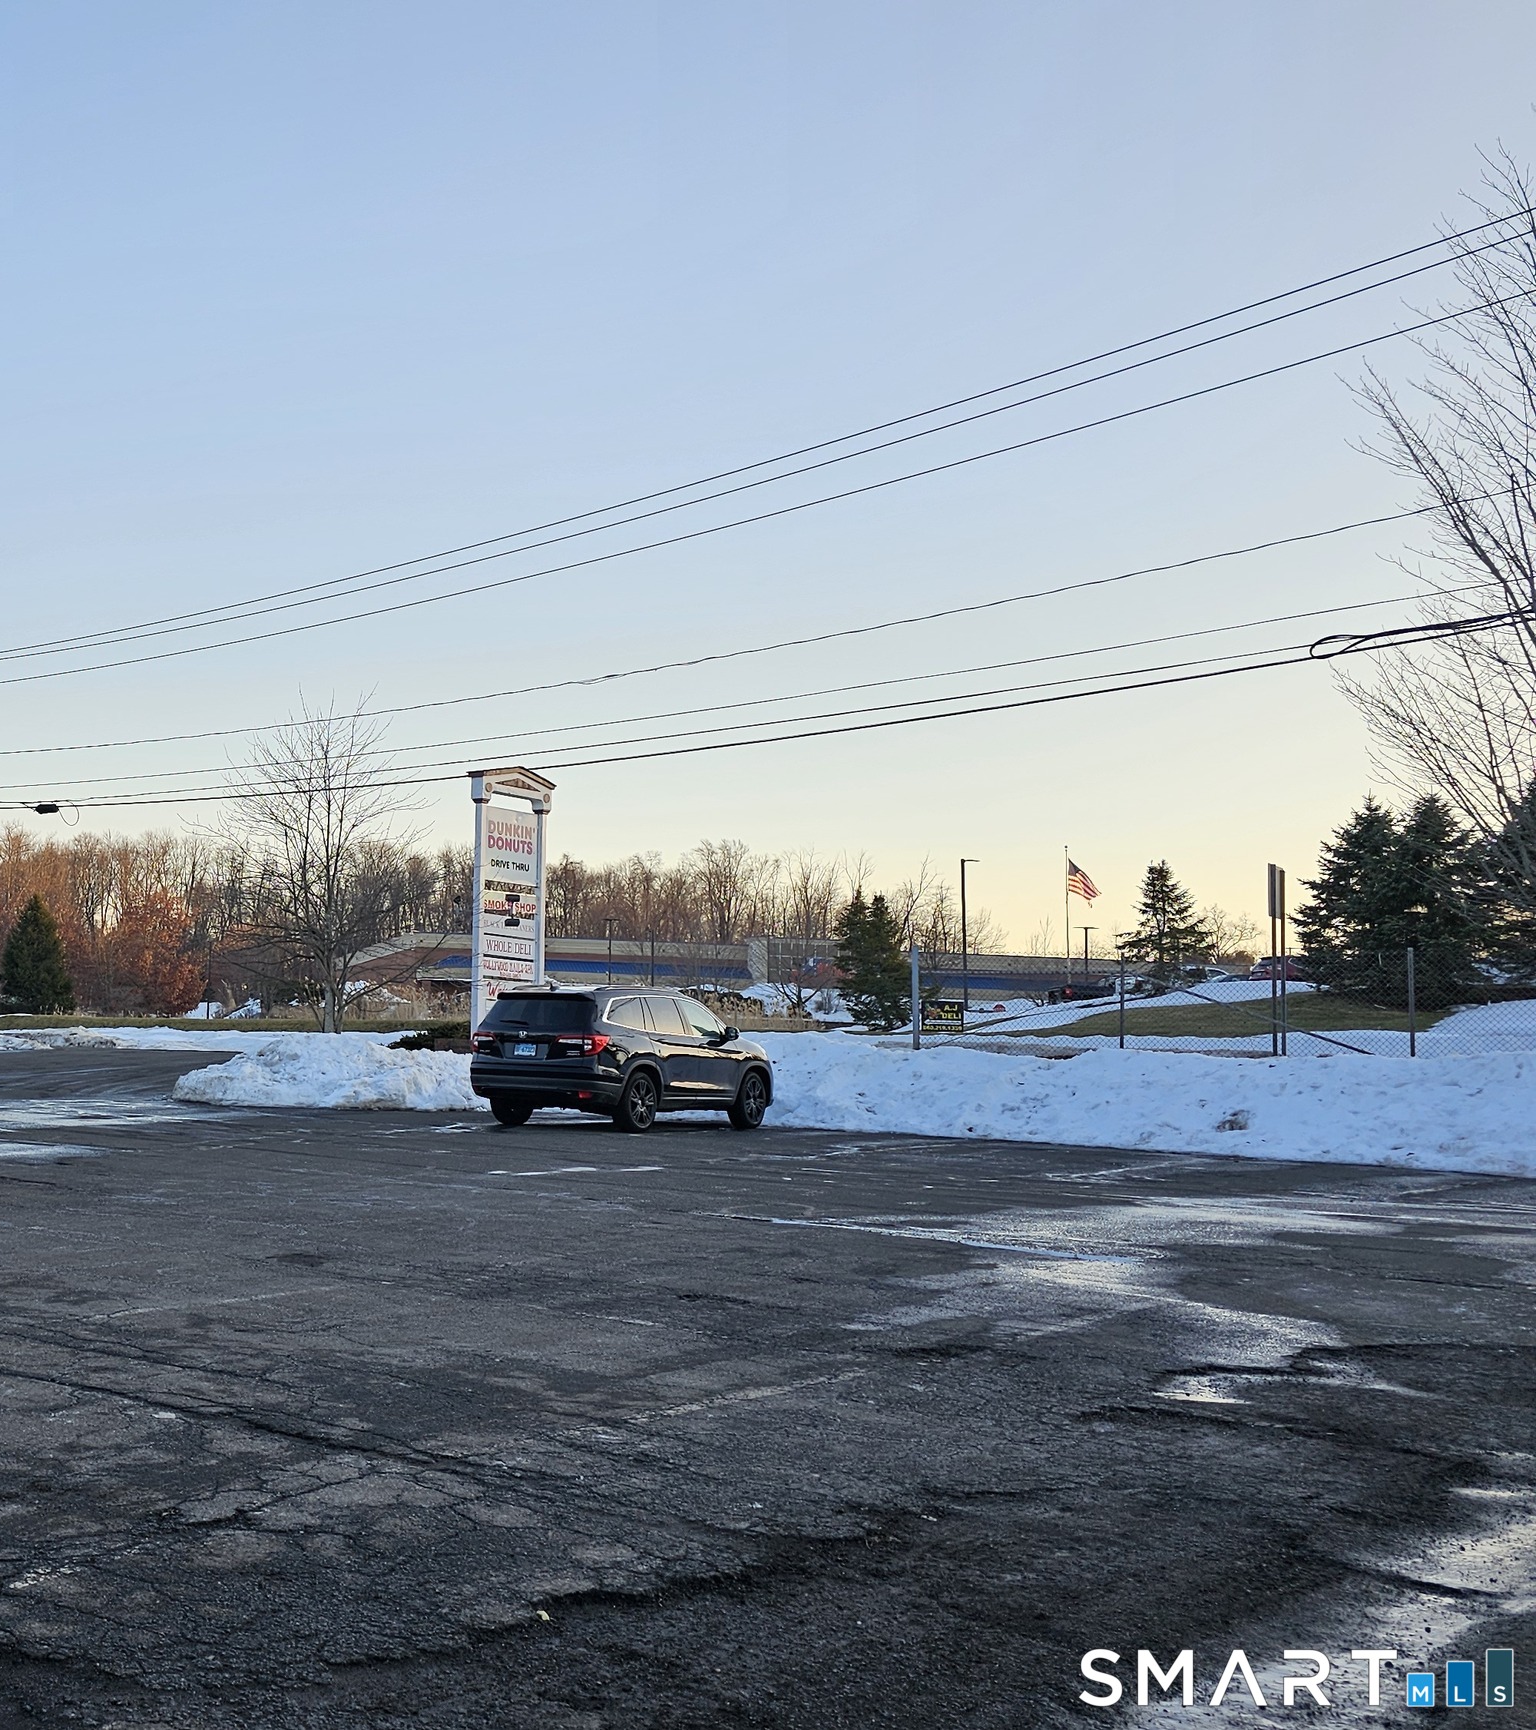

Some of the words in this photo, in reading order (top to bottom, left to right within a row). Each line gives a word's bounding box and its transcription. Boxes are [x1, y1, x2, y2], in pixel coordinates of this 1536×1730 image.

[487, 820, 535, 840] DUNKIN'
[487, 835, 533, 855] DONUTS
[490, 859, 510, 870] DRIVE
[512, 861, 530, 872] THRU
[515, 903, 537, 913] SHOP
[486, 939, 512, 953] WHOLE
[514, 942, 532, 956] DELI
